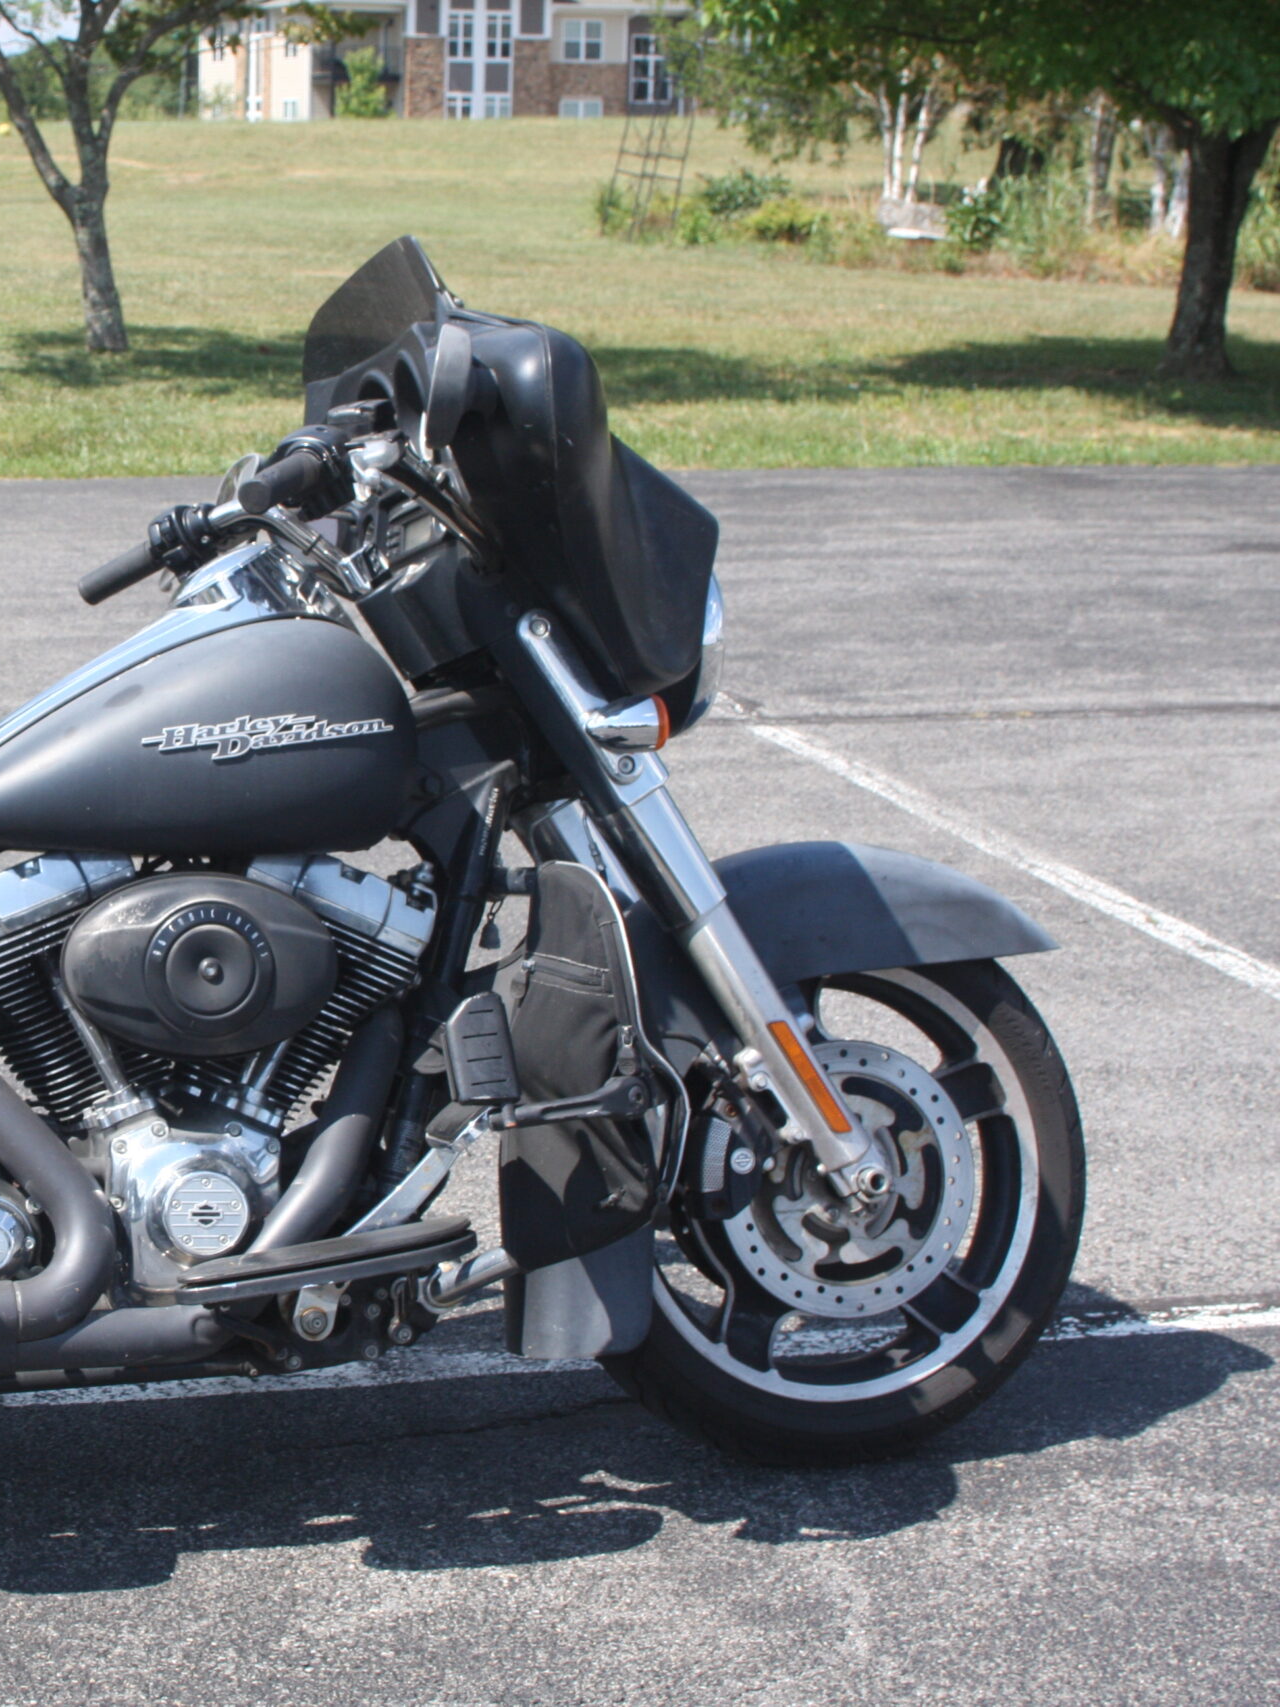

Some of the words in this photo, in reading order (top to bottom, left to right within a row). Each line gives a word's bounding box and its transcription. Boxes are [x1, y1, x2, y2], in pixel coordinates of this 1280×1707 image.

[141, 713, 316, 751] Harley
[211, 719, 393, 760] Davidson
[168, 908, 216, 932] CUBIC
